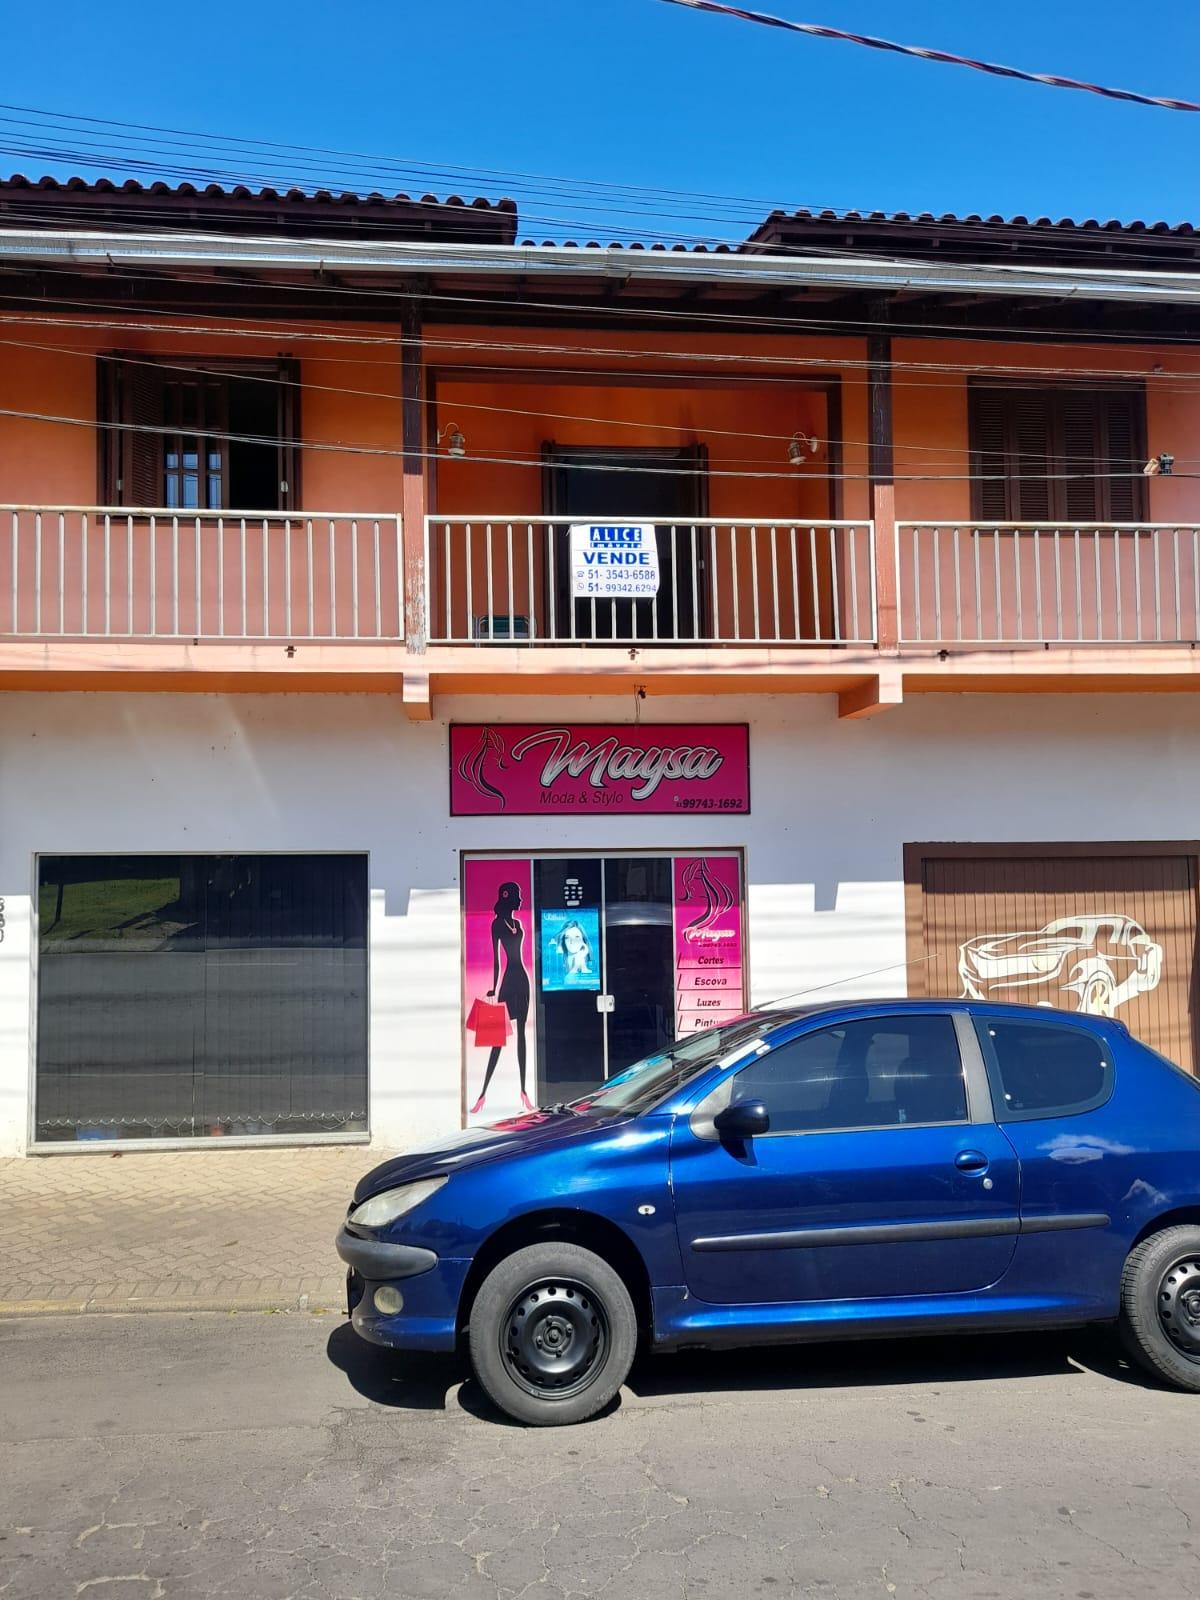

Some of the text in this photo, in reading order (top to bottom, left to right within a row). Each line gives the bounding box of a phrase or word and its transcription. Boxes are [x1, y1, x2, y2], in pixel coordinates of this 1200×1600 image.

[592, 527, 641, 541] ALICE
[583, 551, 650, 565] VENDE
[605, 569, 656, 580] 3543-6588
[511, 729, 723, 800] Maysa
[539, 791, 624, 806] Moda & Stylo
[682, 798, 743, 809] 99743-1692
[697, 956, 725, 965] Cortes
[694, 977, 728, 986] Escova
[696, 998, 722, 1007] Luzes
